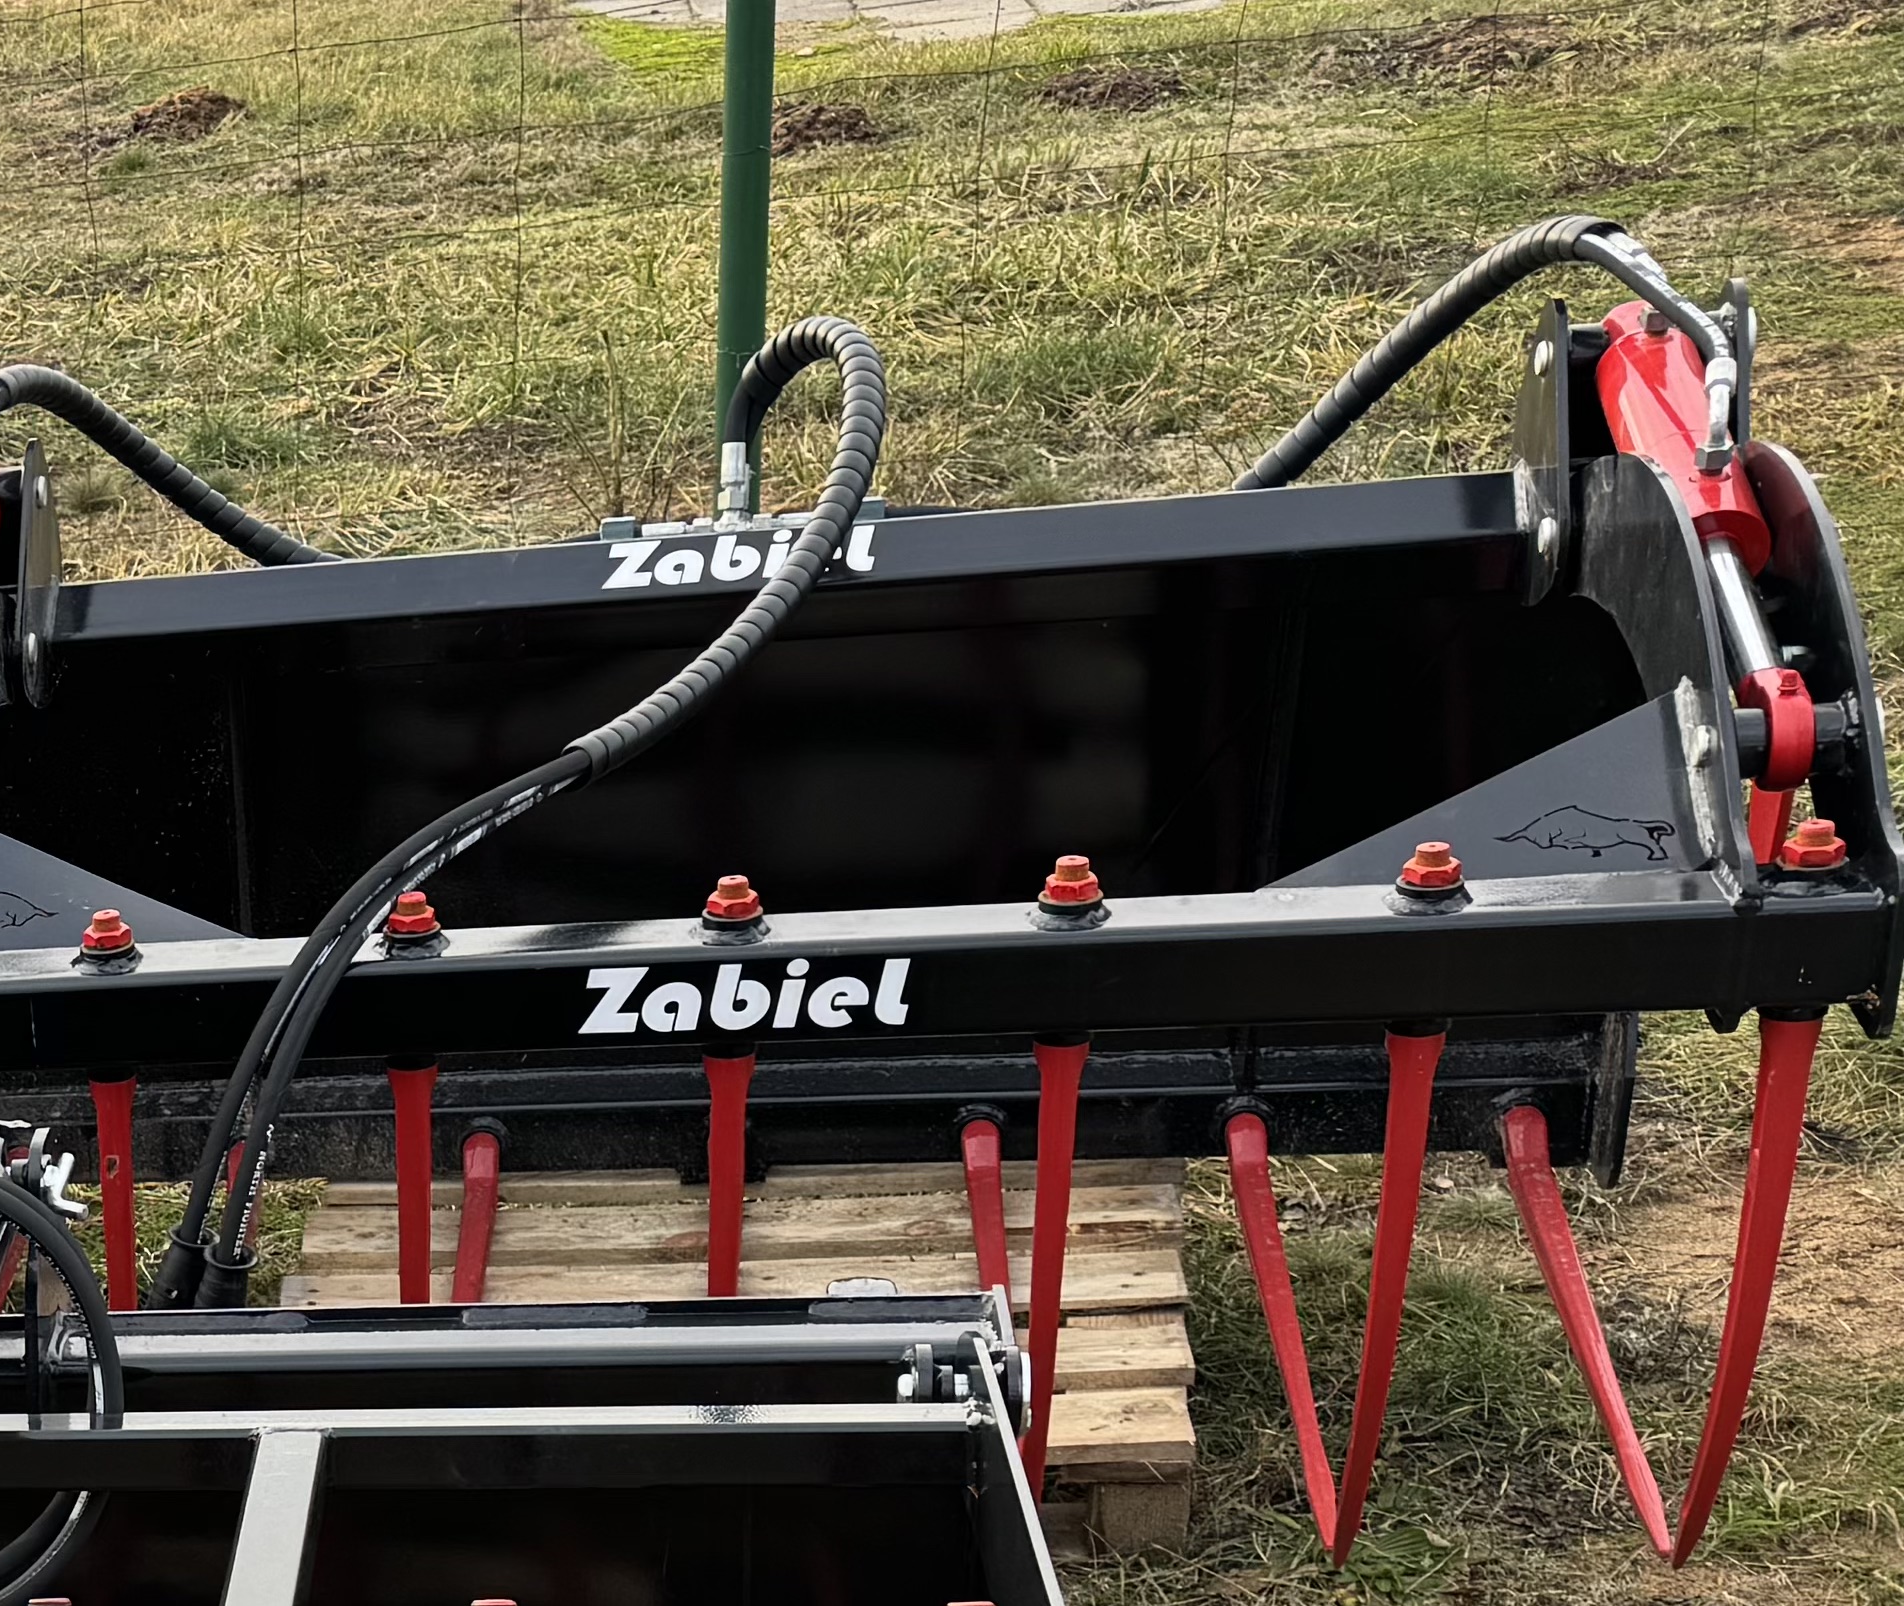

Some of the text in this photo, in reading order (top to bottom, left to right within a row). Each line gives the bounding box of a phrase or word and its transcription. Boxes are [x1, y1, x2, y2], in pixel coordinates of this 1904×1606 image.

[601, 525, 876, 590] Zabil
[578, 958, 911, 1034] Zabiel
[248, 1151, 267, 1196] NORTH
